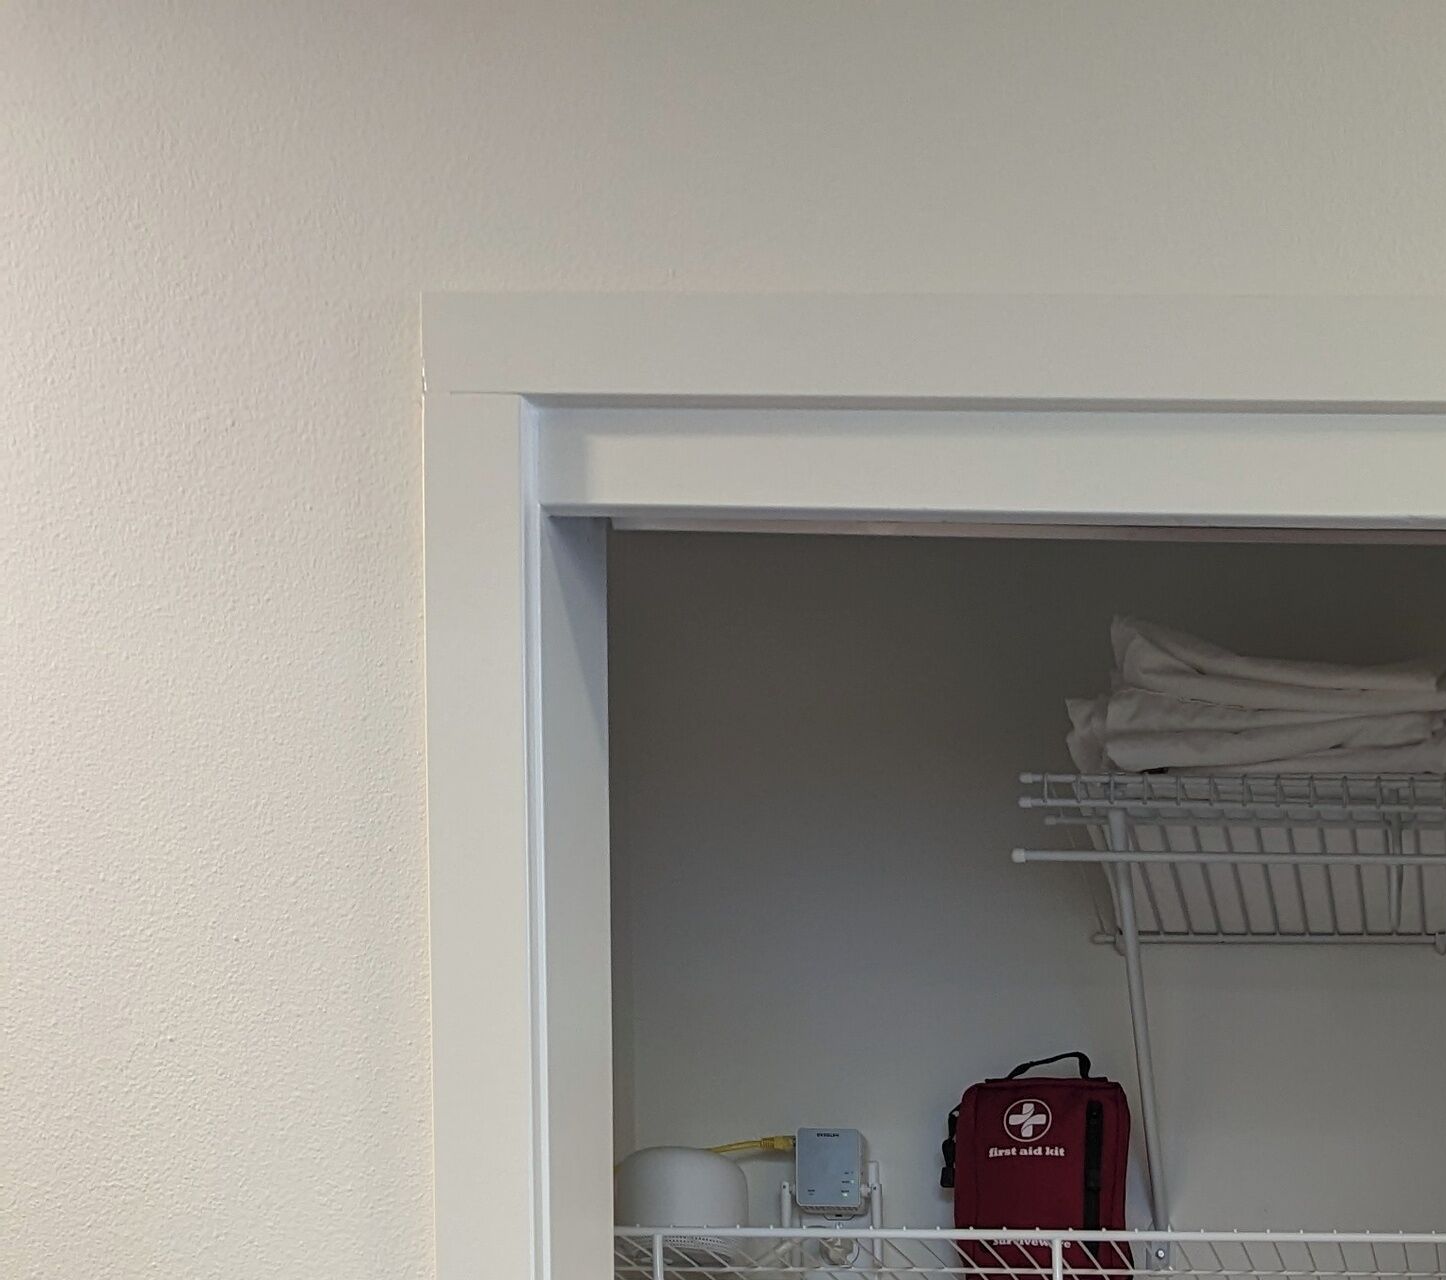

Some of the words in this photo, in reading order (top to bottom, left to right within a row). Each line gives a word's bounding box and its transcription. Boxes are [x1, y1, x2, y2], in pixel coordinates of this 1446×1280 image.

[988, 1148, 1017, 1158] first
[1019, 1147, 1043, 1156] aid
[1045, 1147, 1065, 1156] kit
